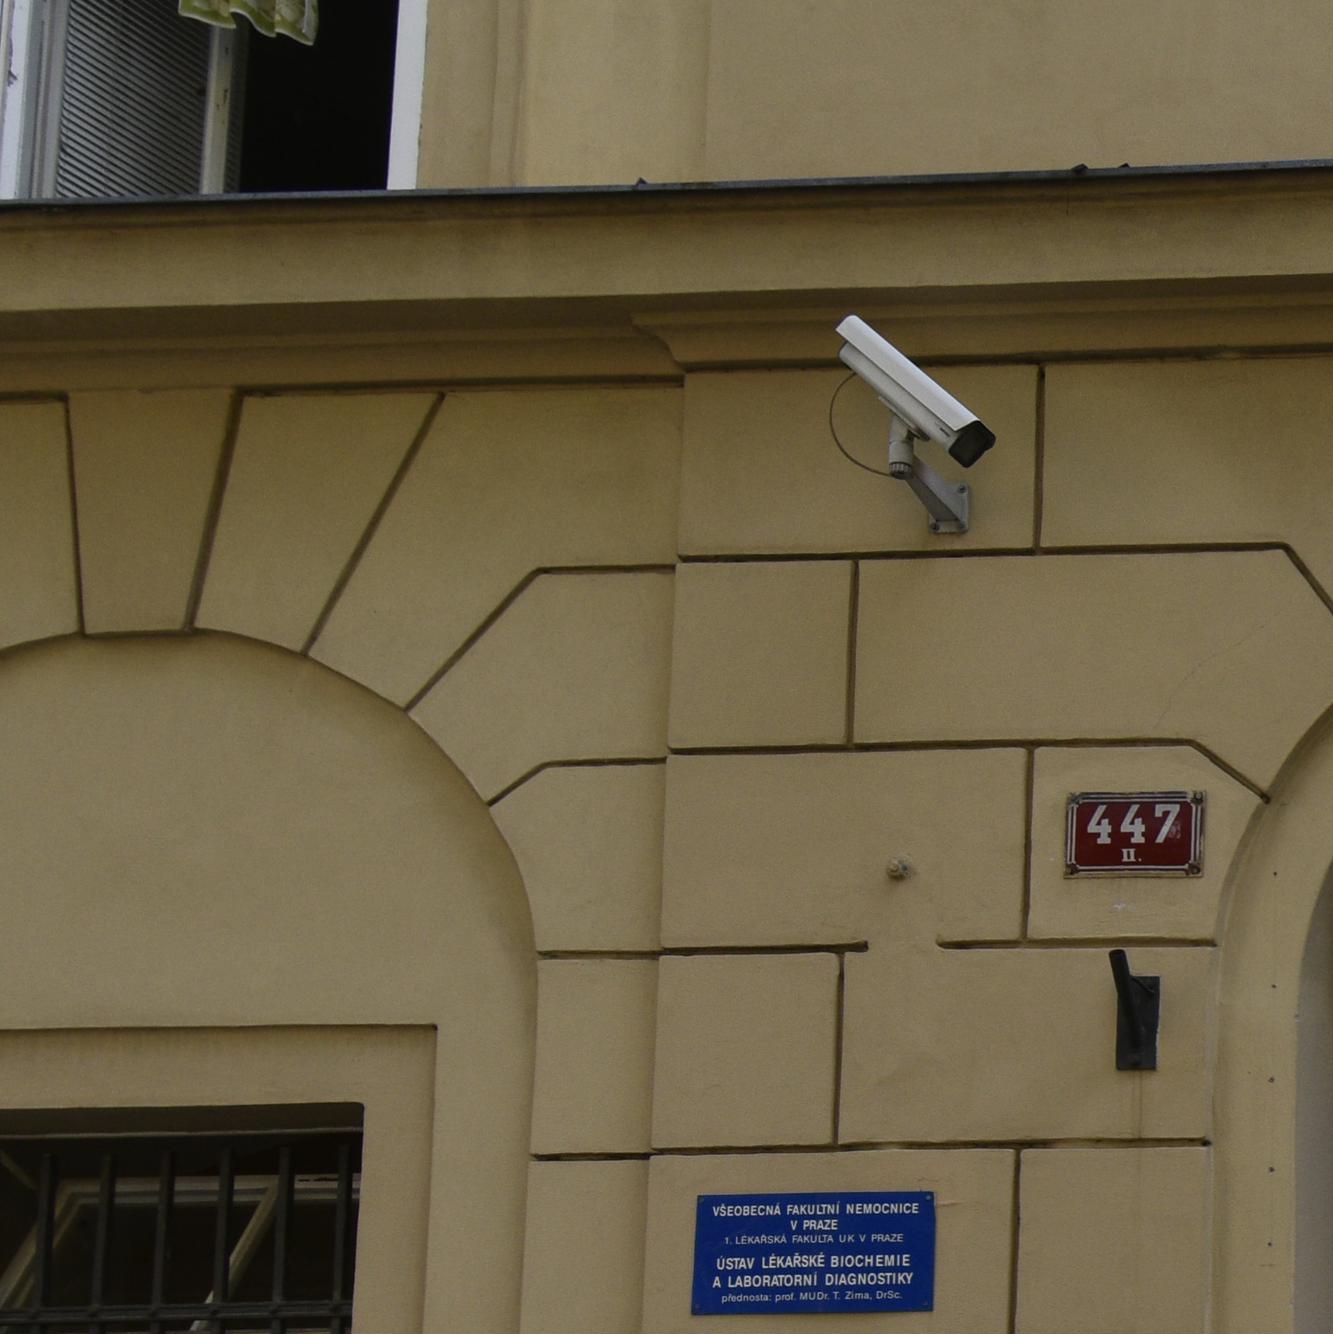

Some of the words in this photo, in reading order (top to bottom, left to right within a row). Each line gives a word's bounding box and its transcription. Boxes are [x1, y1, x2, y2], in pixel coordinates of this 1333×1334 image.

[1087, 804, 1180, 844] 447
[712, 1204, 782, 1217] VŠEOBECNÁ
[786, 1201, 840, 1216] FAKULTNÍ
[846, 1203, 919, 1215] NEMOCNICE
[790, 1220, 798, 1231] V
[803, 1219, 838, 1231] PRAZE
[724, 1237, 733, 1245] 1.
[735, 1234, 787, 1245] LÉKAŘSKÁ
[792, 1234, 834, 1244] FAKULTA
[839, 1235, 855, 1243] UK
[859, 1234, 866, 1243] V
[871, 1234, 904, 1243] PRAZE
[716, 1257, 755, 1270] ÚSTAV
[762, 1252, 825, 1269] LÉKAŘSKÉ
[831, 1254, 911, 1268] BIOCHEMIE
[712, 1277, 722, 1288] A
[727, 1273, 818, 1288] LABORATORNÍ
[825, 1273, 913, 1286] DIAGNOSTIKY
[721, 1293, 771, 1304] přednosta:
[800, 1291, 830, 1300] MUDr.
[833, 1291, 841, 1300] T.
[845, 1291, 873, 1301] Zima,
[876, 1291, 903, 1299] DrSc.
